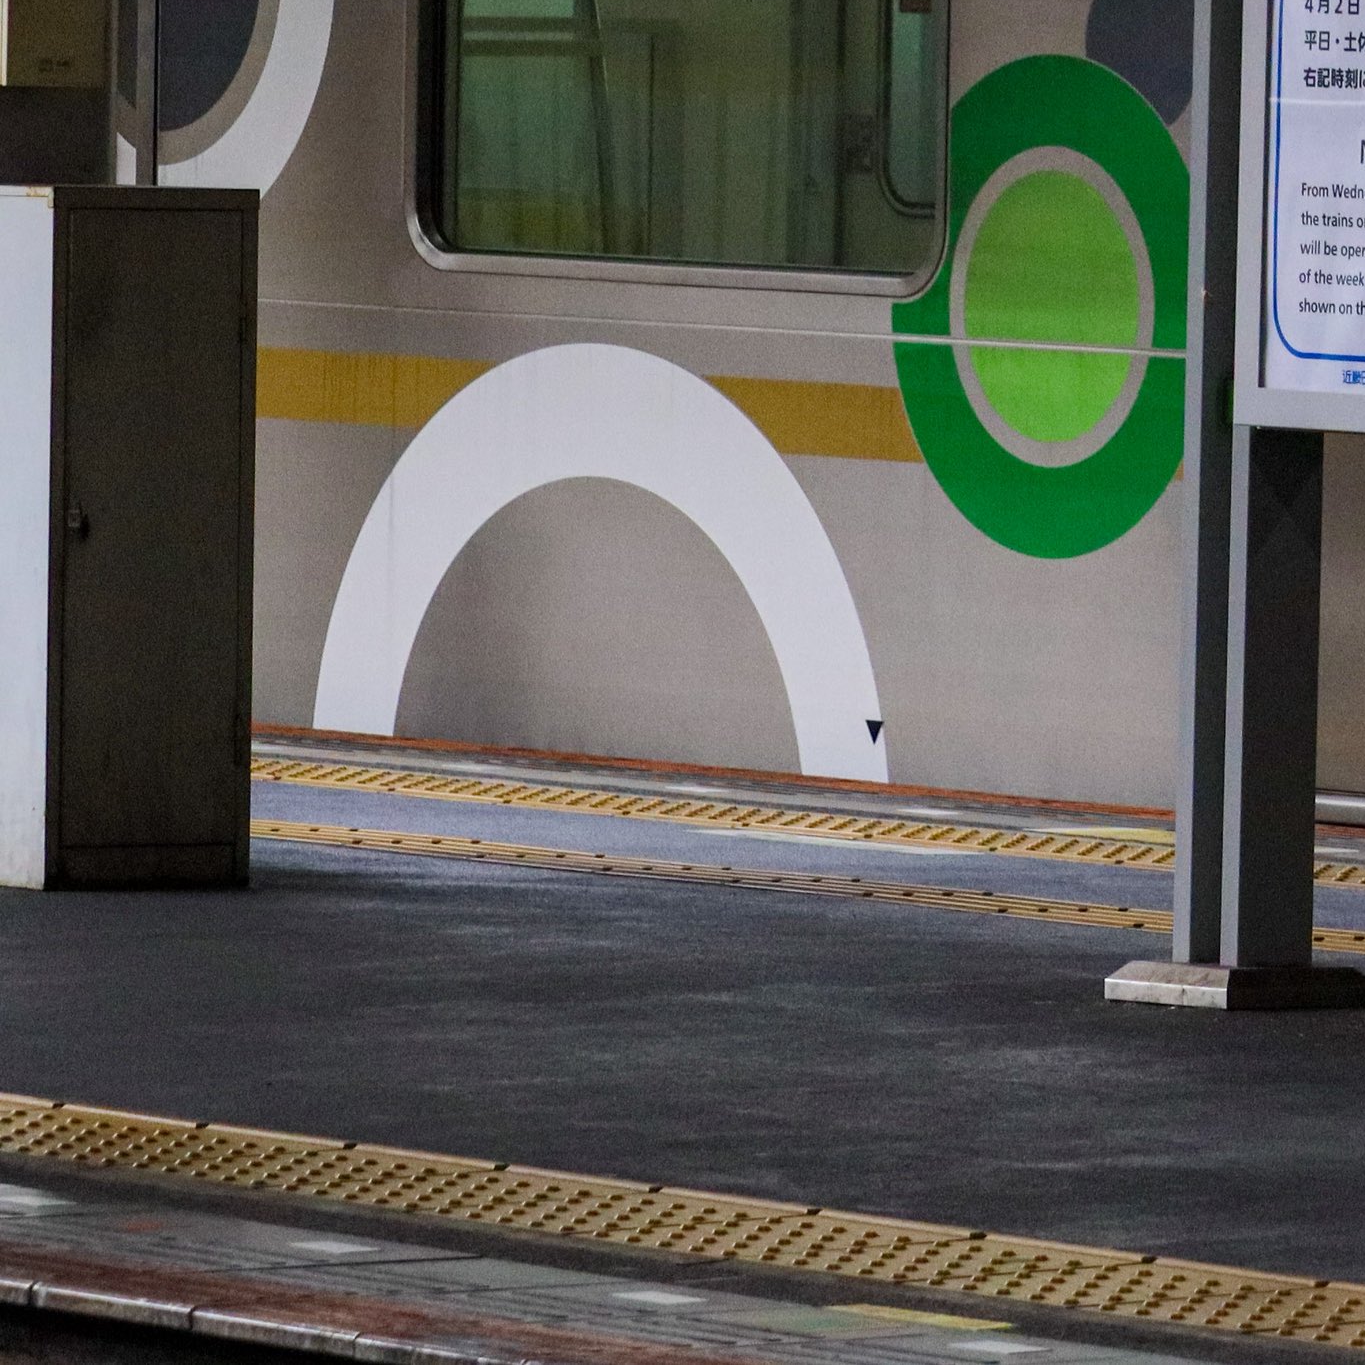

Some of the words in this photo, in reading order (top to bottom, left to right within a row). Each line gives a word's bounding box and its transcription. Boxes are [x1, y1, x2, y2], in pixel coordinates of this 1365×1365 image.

[1302, 183, 1328, 197] From
[1301, 211, 1319, 225] the
[1322, 213, 1353, 227] trains
[1300, 240, 1320, 254] will
[1324, 241, 1337, 256] be
[1299, 269, 1311, 283] of
[1314, 270, 1332, 284] the
[1336, 272, 1364, 286] week
[1299, 298, 1335, 313] shown
[1339, 304, 1352, 314] on
